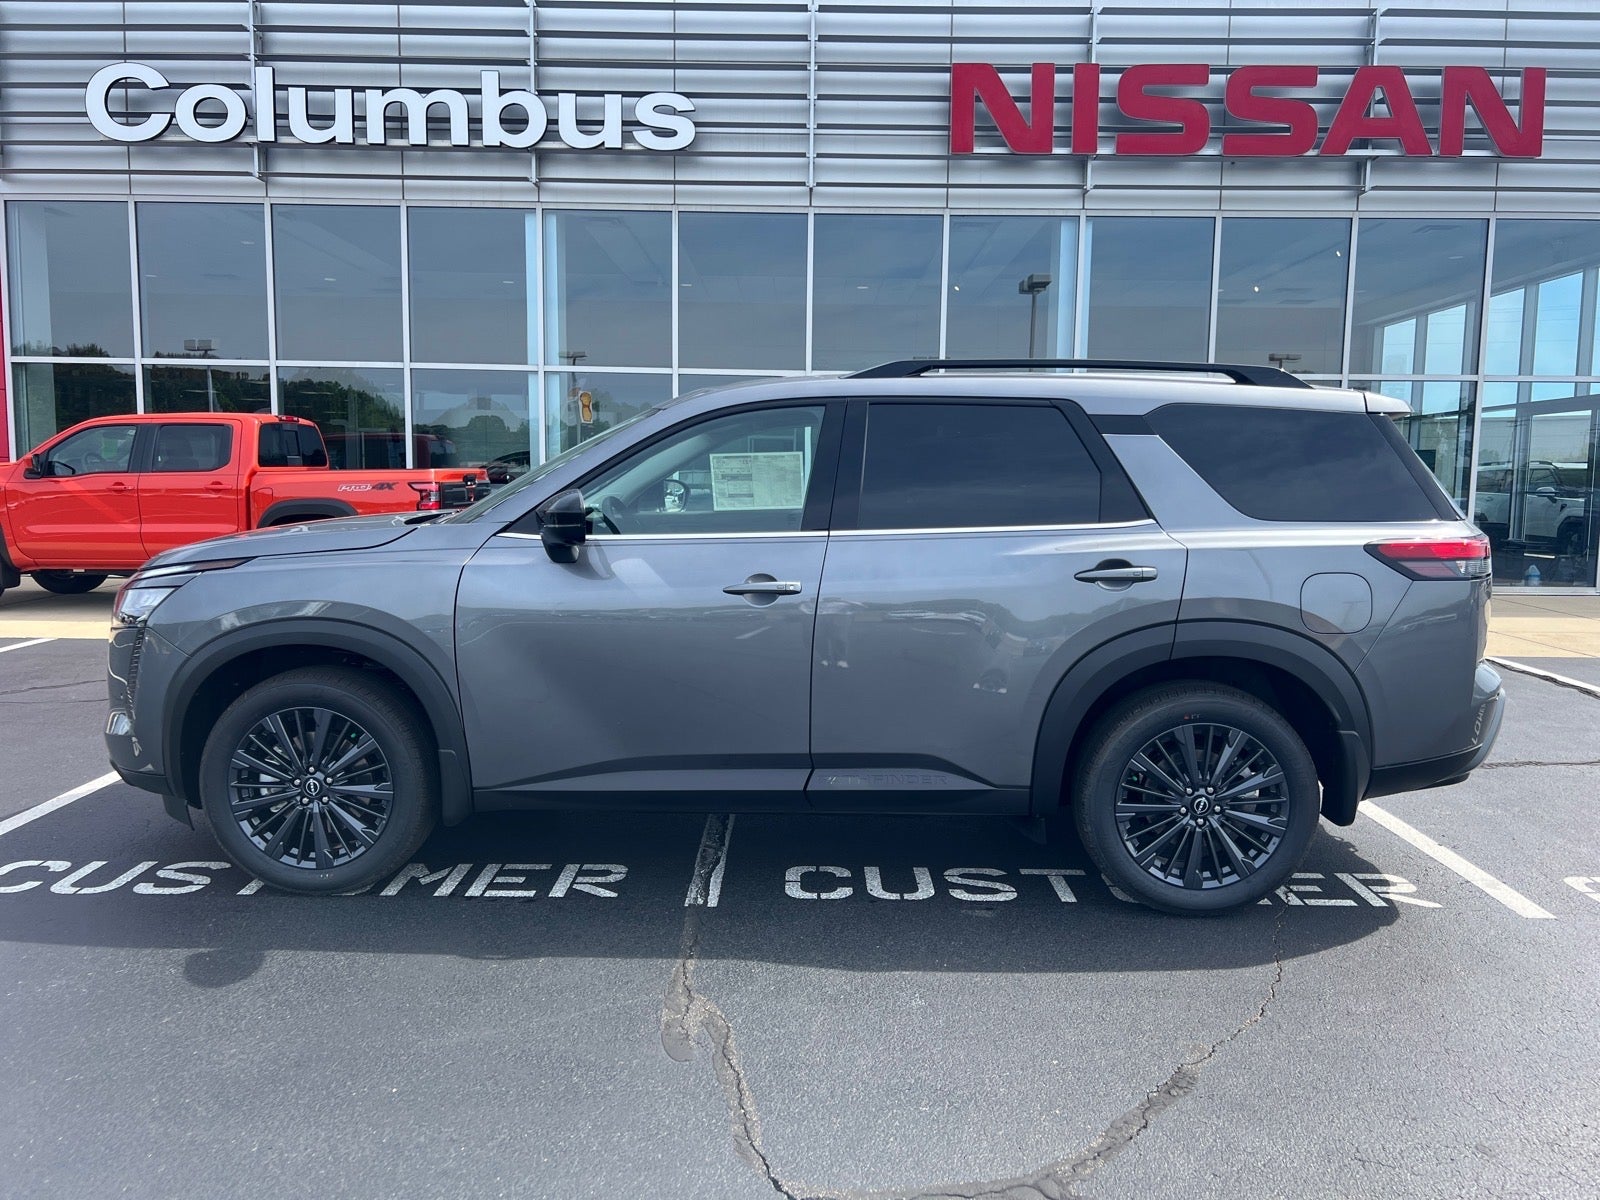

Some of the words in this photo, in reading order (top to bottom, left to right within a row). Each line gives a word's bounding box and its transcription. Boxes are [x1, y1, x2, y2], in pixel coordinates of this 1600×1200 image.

[85, 62, 697, 152] Columbus
[950, 63, 1546, 158] NISSAN
[0, 860, 627, 897] CUSMER
[785, 864, 1442, 908] CUSTER
